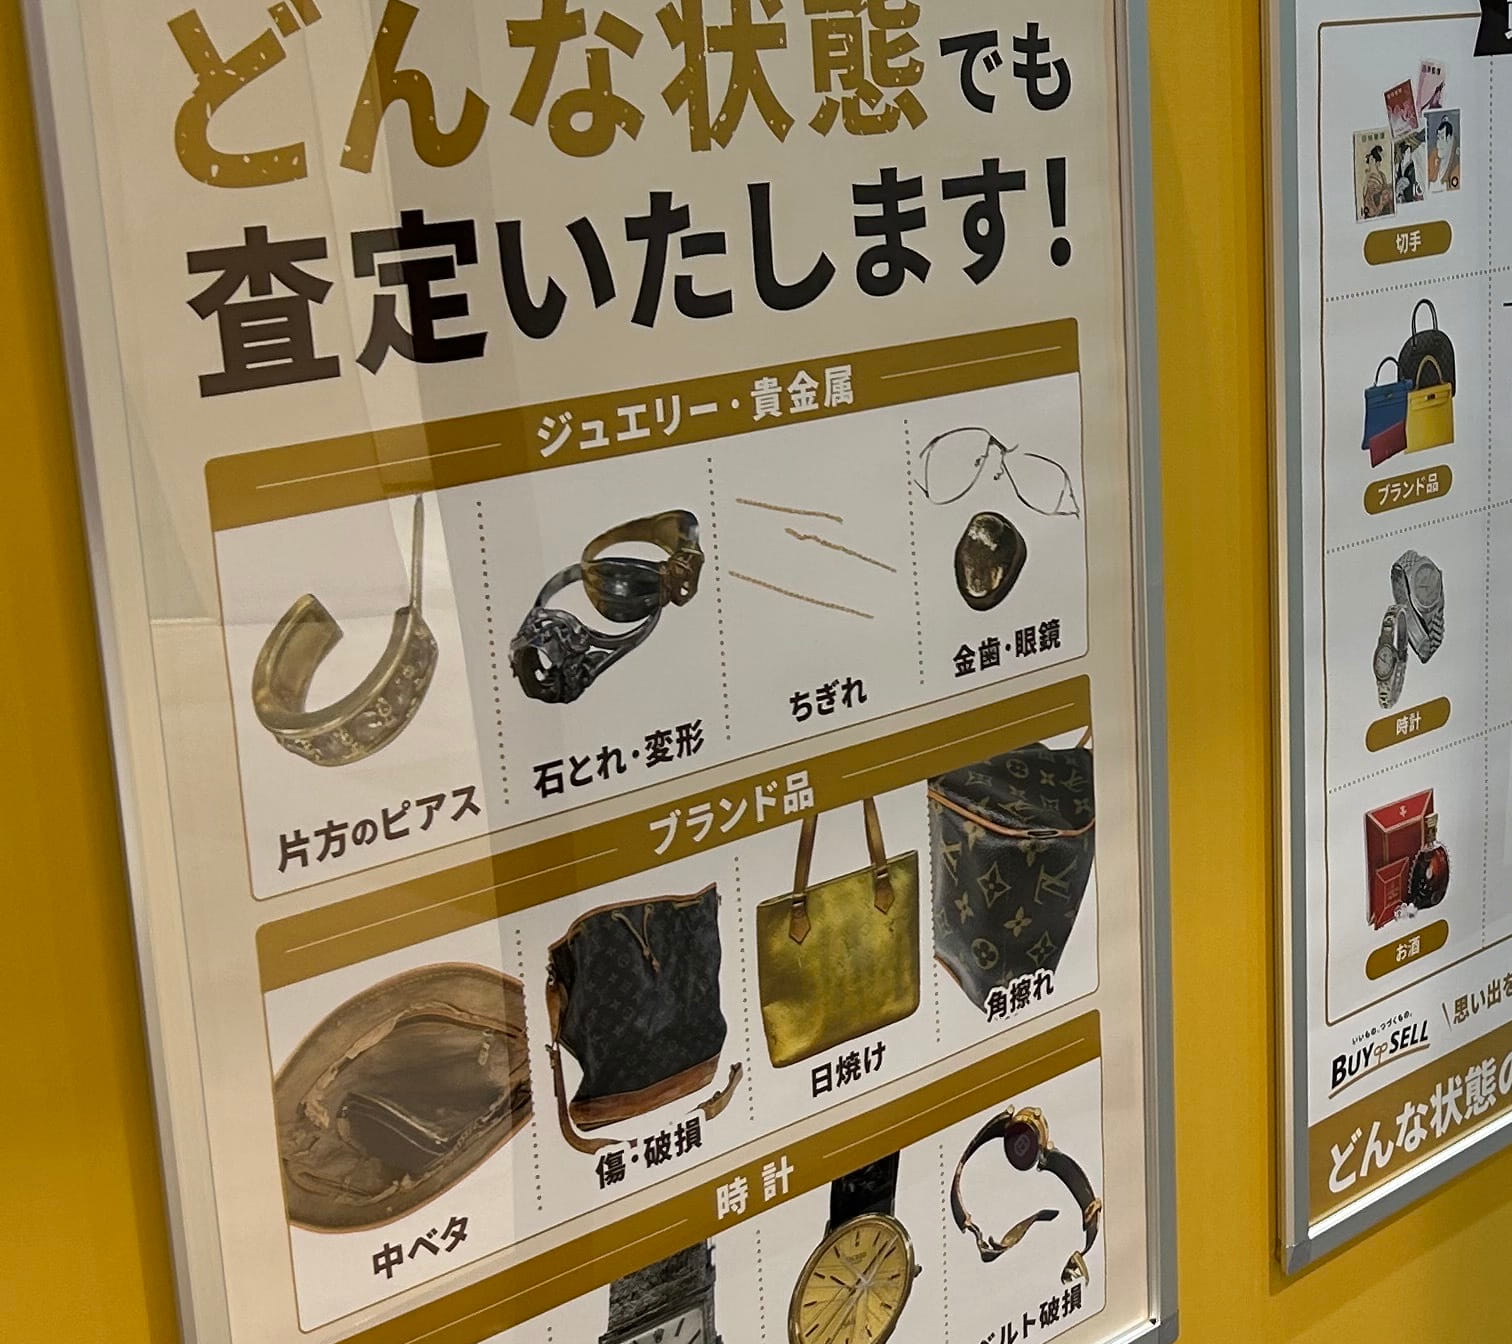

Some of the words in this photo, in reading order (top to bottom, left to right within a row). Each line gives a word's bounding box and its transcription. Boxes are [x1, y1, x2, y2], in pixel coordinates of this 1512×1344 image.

[1395, 229, 1422, 255] 切手
[185, 156, 1071, 398] 査定いたします!
[536, 364, 855, 456] ジュエリー・貴金属
[1378, 474, 1440, 507] ブランド品
[953, 618, 1062, 678] 金歯・眼鏡
[789, 676, 868, 723] ちぎれ
[1396, 711, 1422, 737] 時計
[533, 720, 704, 799] 石とれ・変形
[277, 785, 481, 874] 片方のピアス
[649, 769, 815, 856] ブランド品
[1395, 936, 1421, 962] お酒
[986, 970, 1056, 1024] 角擦れ
[811, 1040, 886, 1098] 日焼け
[595, 1116, 704, 1190] 傷・破損
[715, 1155, 795, 1221] 時計
[371, 1213, 470, 1280] 中ベタ
